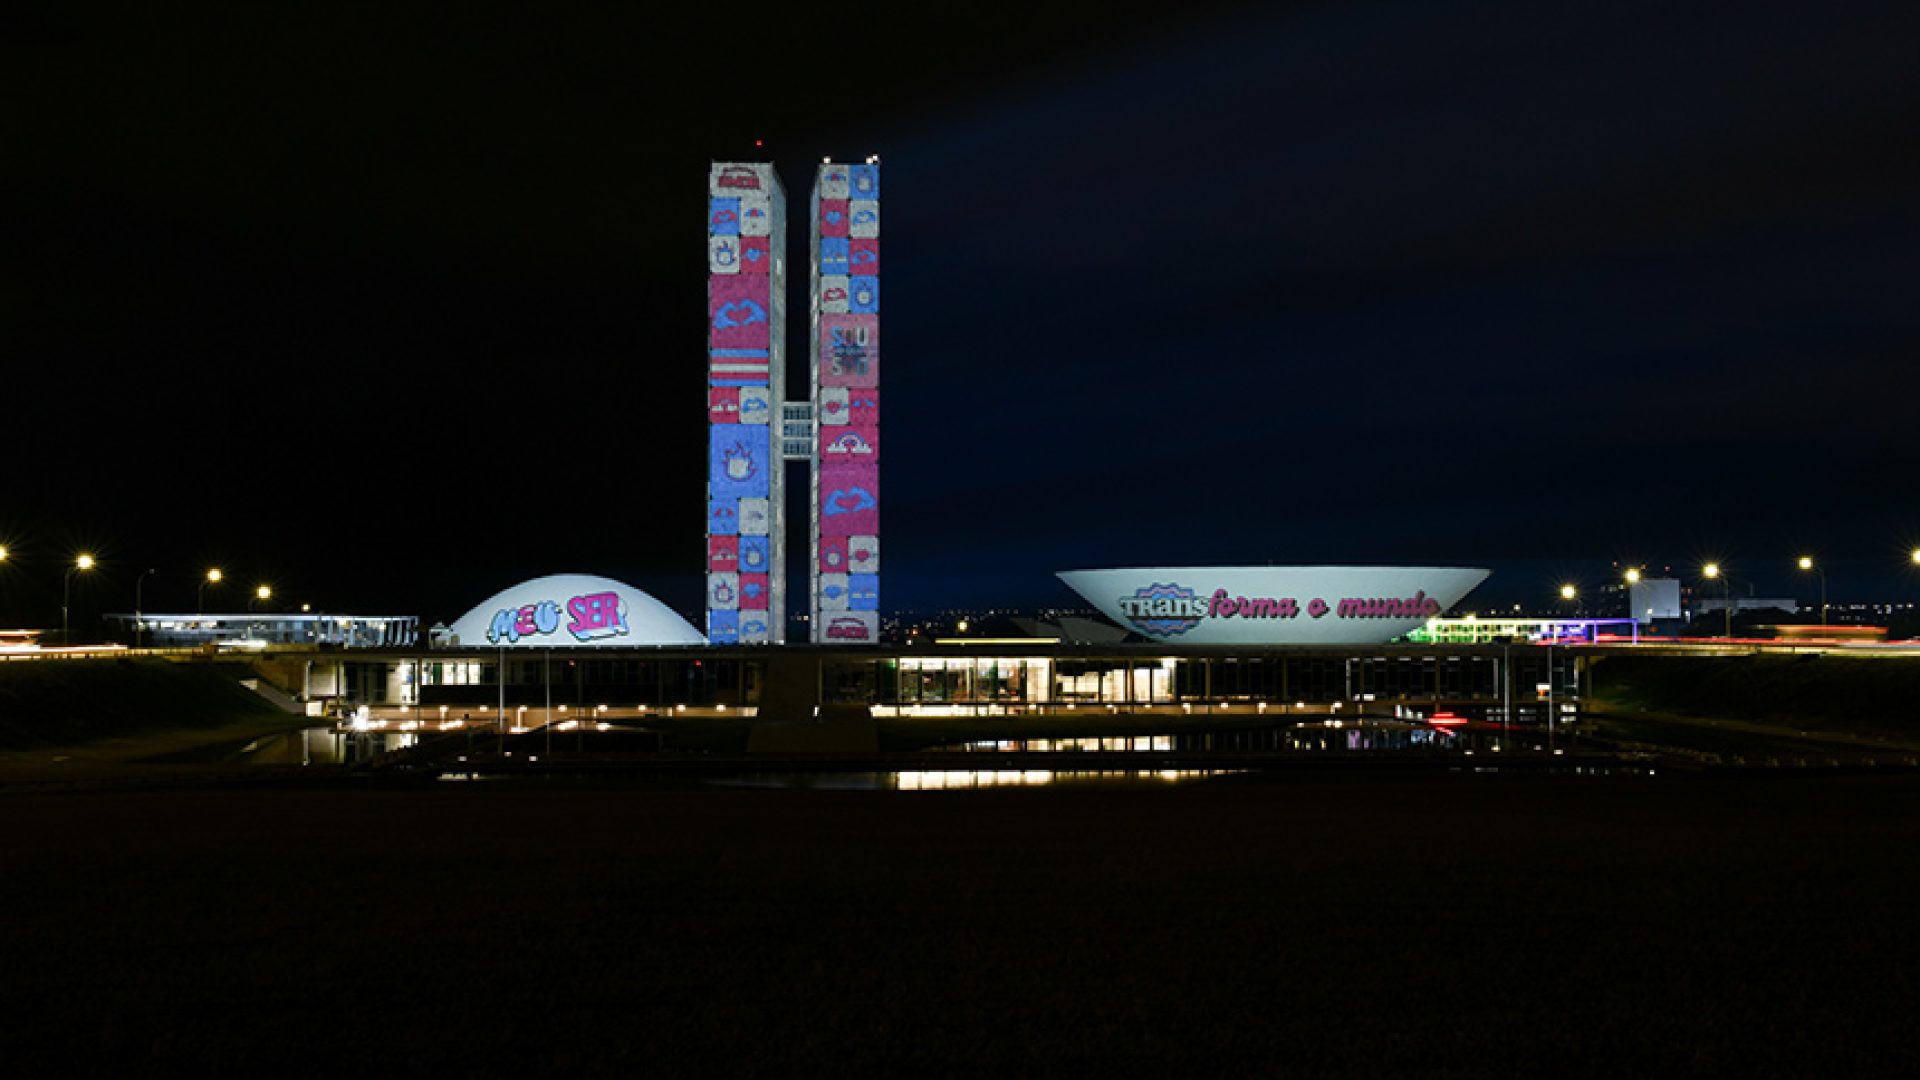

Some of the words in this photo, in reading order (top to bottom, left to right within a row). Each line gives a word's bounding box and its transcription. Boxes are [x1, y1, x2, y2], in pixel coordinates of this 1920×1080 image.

[487, 600, 562, 642] MEU
[566, 591, 629, 641] SER
[1308, 598, 1330, 618] o
[1337, 589, 1441, 618] mundo
